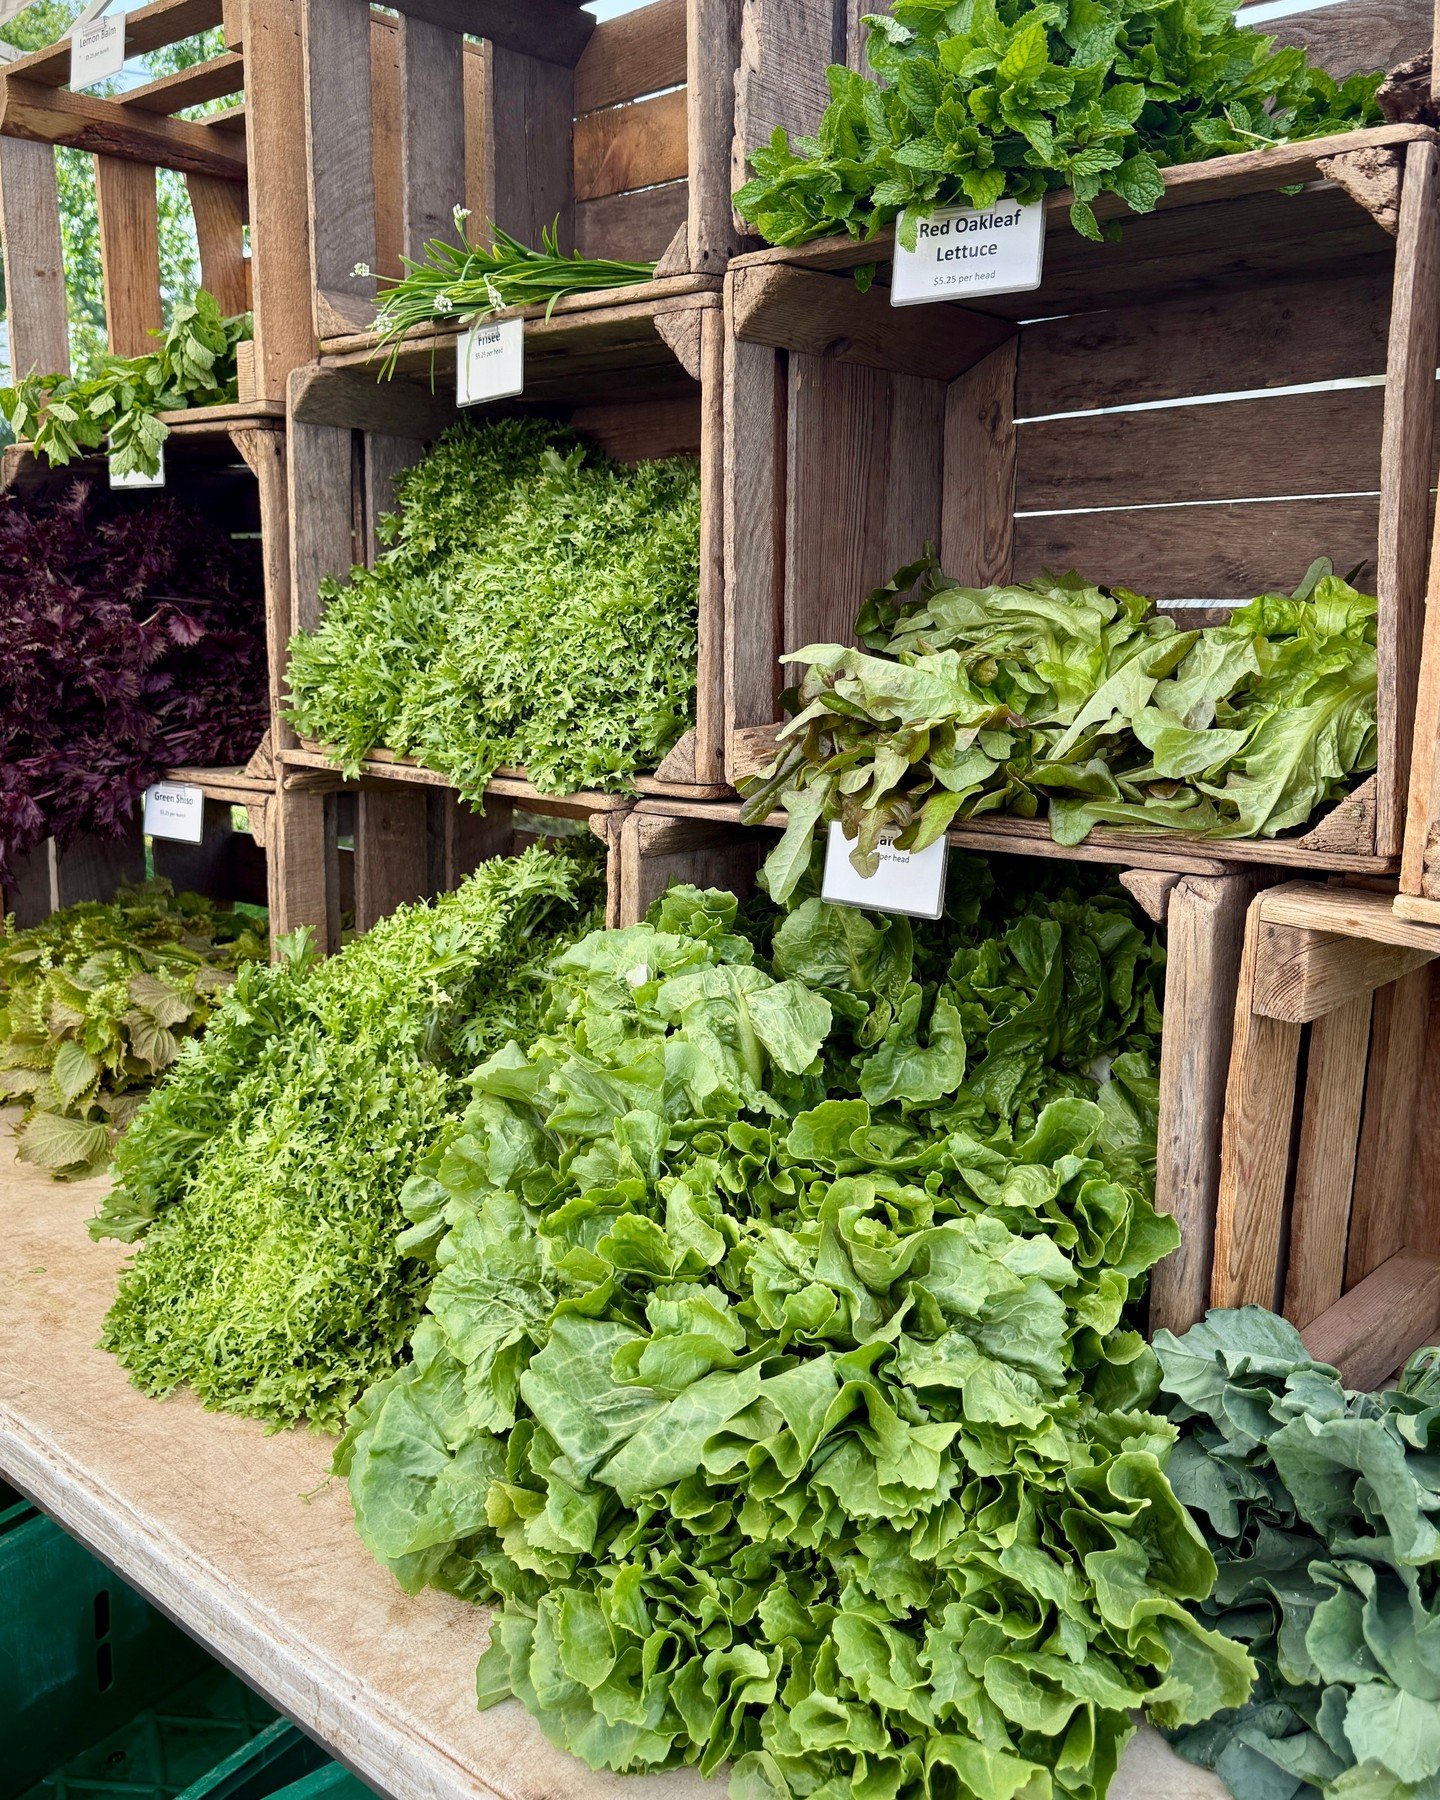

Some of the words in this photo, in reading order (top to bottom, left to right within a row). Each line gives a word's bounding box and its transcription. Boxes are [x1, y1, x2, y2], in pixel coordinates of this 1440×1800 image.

[80, 34, 99, 48] Lemon
[101, 27, 117, 40] Balm
[919, 220, 950, 238] Red
[955, 208, 1022, 233] Oakleaf
[936, 242, 998, 262] Lettuce
[933, 276, 956, 287] $5.25
[958, 275, 972, 284] per
[974, 270, 996, 281] head
[486, 350, 494, 358] per
[154, 792, 174, 803] Green
[176, 794, 194, 805] Shiso
[892, 854, 910, 864] head
